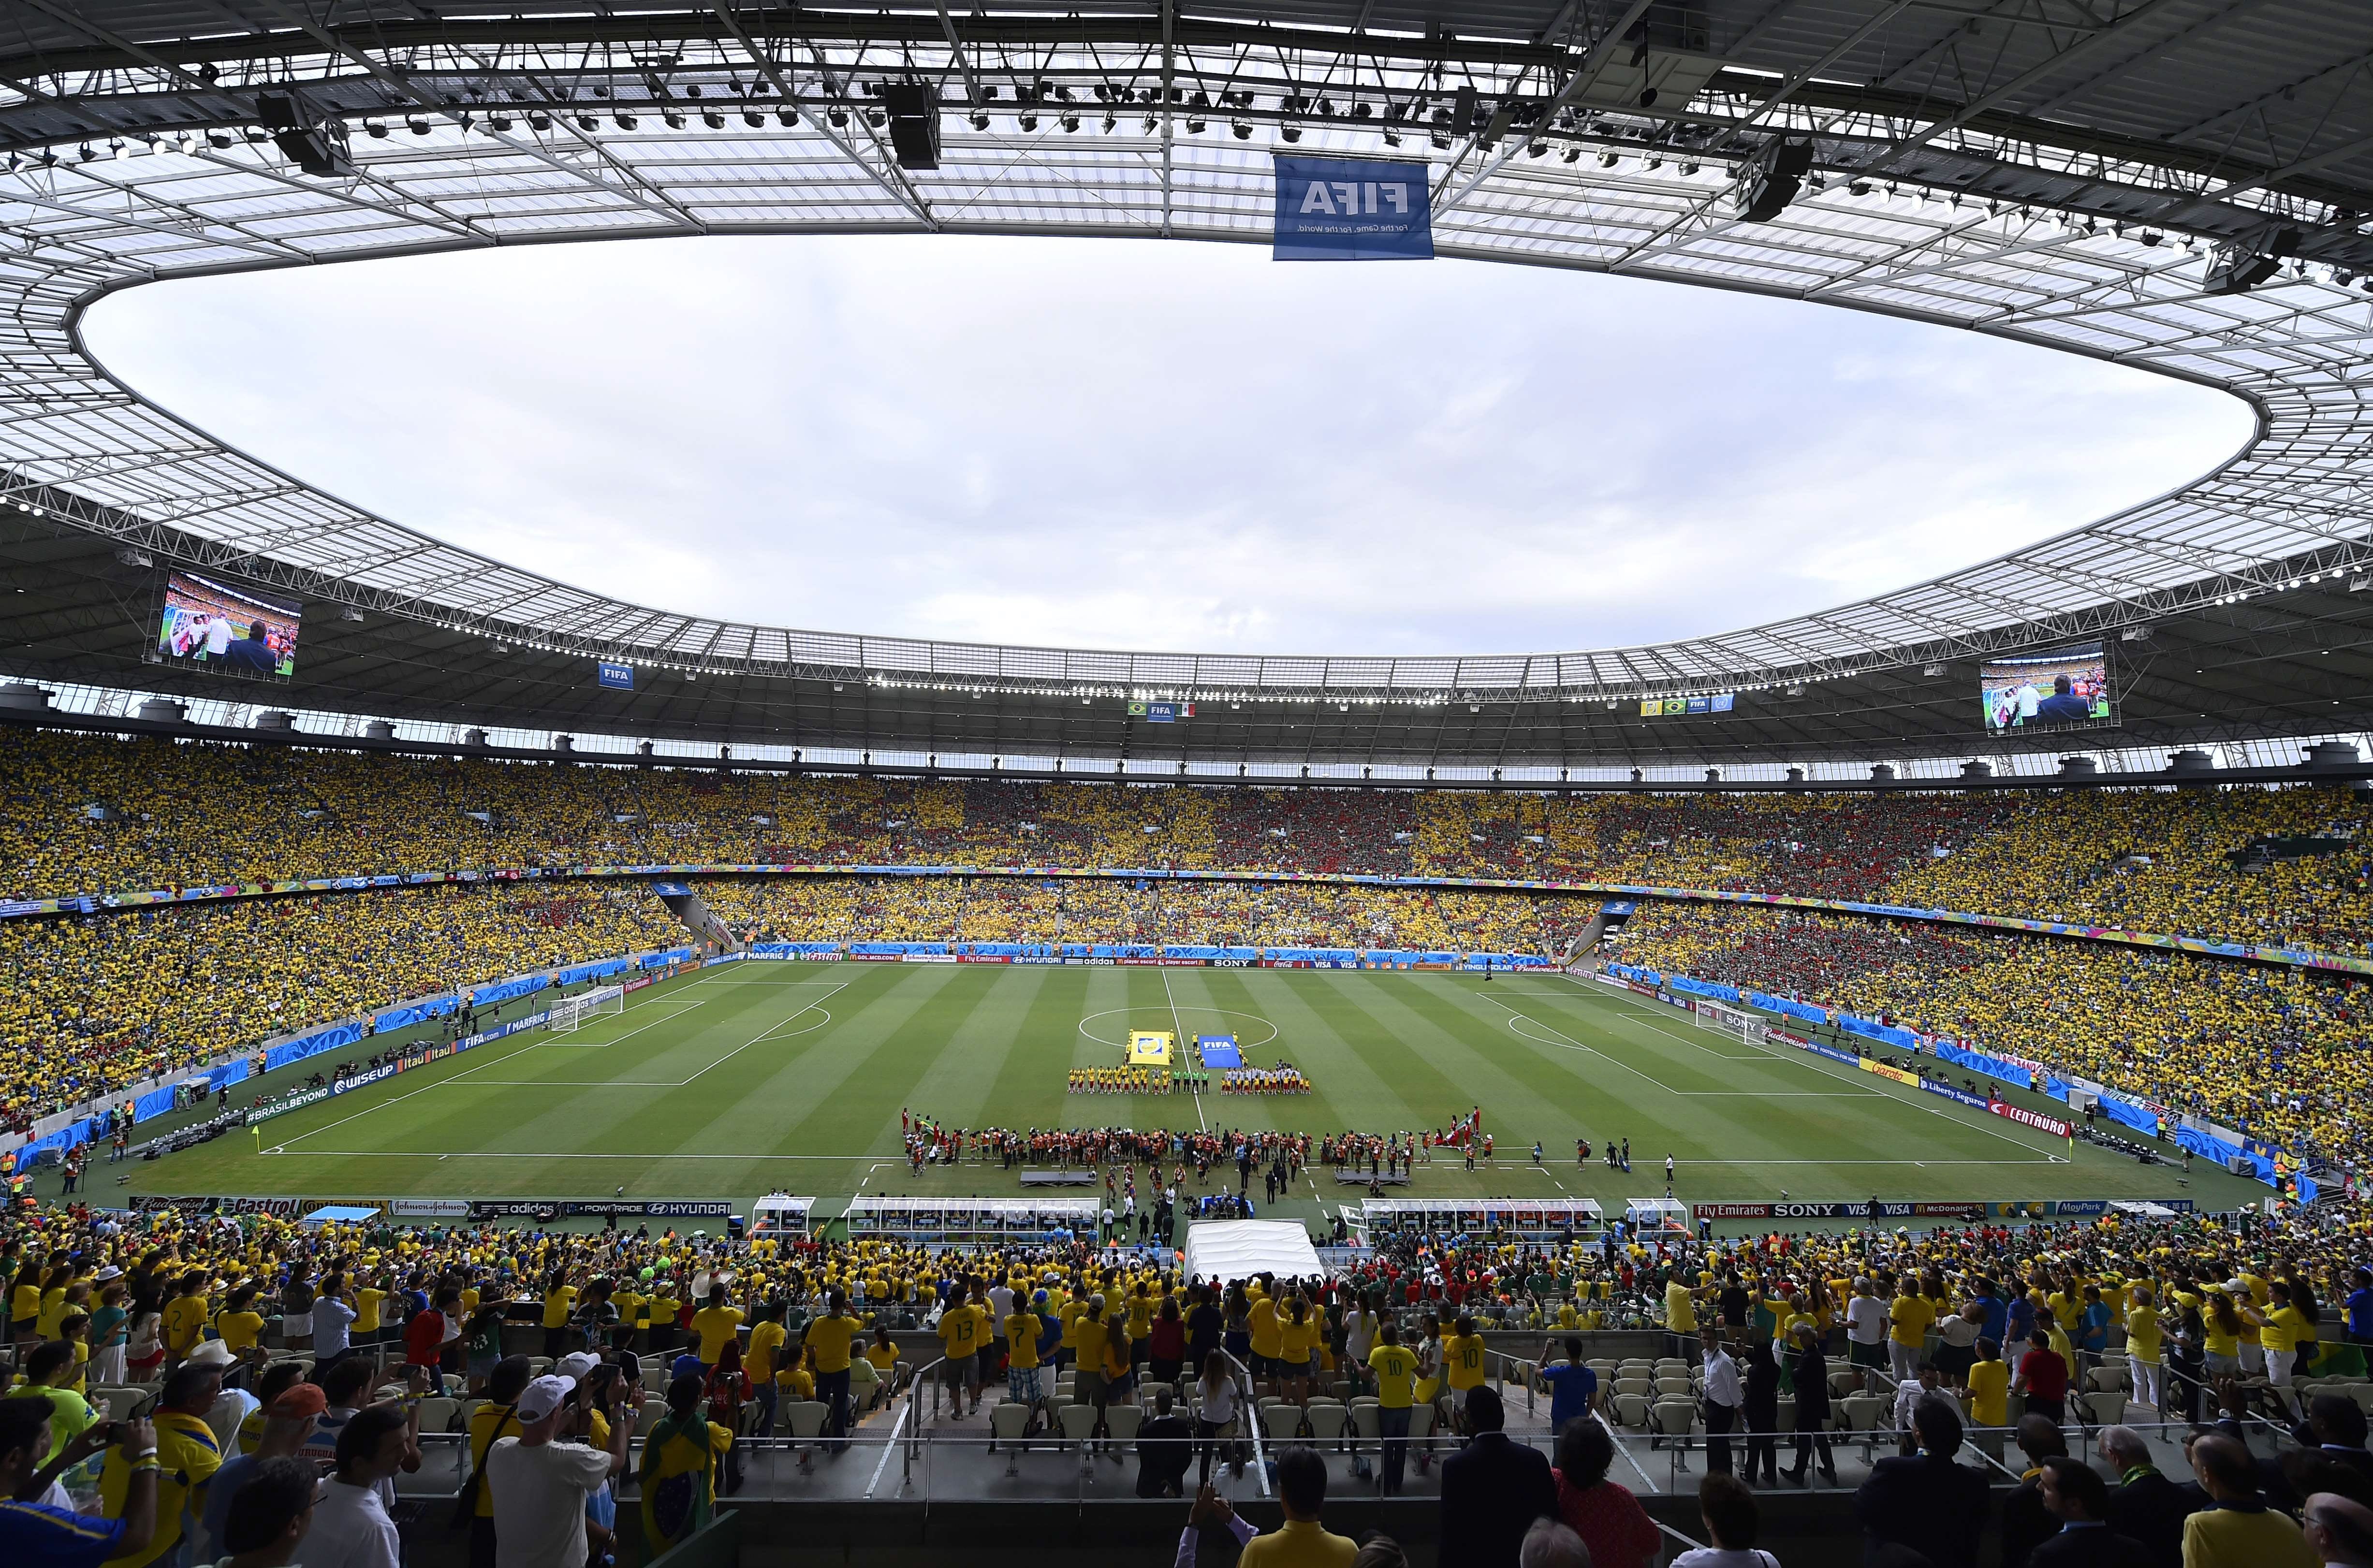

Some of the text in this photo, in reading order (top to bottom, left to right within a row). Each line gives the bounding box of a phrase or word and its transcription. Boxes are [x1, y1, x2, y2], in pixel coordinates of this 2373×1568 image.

[604, 668, 628, 680] FIFA
[1514, 964, 1563, 973] Budweiser
[1571, 967, 1595, 980] Castrol
[633, 979, 650, 988] Emirates
[1657, 992, 1670, 1002] VISA
[1673, 997, 1686, 1008] VISA
[564, 998, 588, 1014] adidas
[512, 1012, 545, 1032] MARFRIG
[1726, 1015, 1757, 1031] SONY
[465, 1031, 499, 1048] FIFA.com
[1760, 1025, 1808, 1049] Budweiser
[431, 1045, 450, 1060] Itaú
[1808, 1043, 1818, 1051] FIFA
[1820, 1047, 1839, 1058] FOOTBALL
[1847, 1056, 1859, 1064] HOPE
[404, 1054, 425, 1070] Itaú
[1872, 1061, 1903, 1081] Garoto
[1929, 1083, 1986, 1108] Liberty Seguros
[247, 1088, 328, 1123] #BRASILBEYOND
[2009, 1107, 2065, 1135] CENTAURO
[136, 1196, 209, 1211] Budweiser
[235, 1199, 297, 1214] Castrol
[510, 1203, 554, 1214] adidas
[670, 1205, 731, 1214] HYUNDAI
[1698, 1205, 1765, 1218] Fly Emirates
[1775, 1205, 1835, 1217] SONY
[1883, 1205, 1910, 1215] VISA
[172, 1310, 182, 1331] 2
[1133, 1306, 1145, 1321] 10
[955, 1320, 973, 1342] 13
[1013, 1327, 1024, 1348] 7
[1462, 1349, 1478, 1369] 10
[1387, 1359, 1402, 1377] 10
